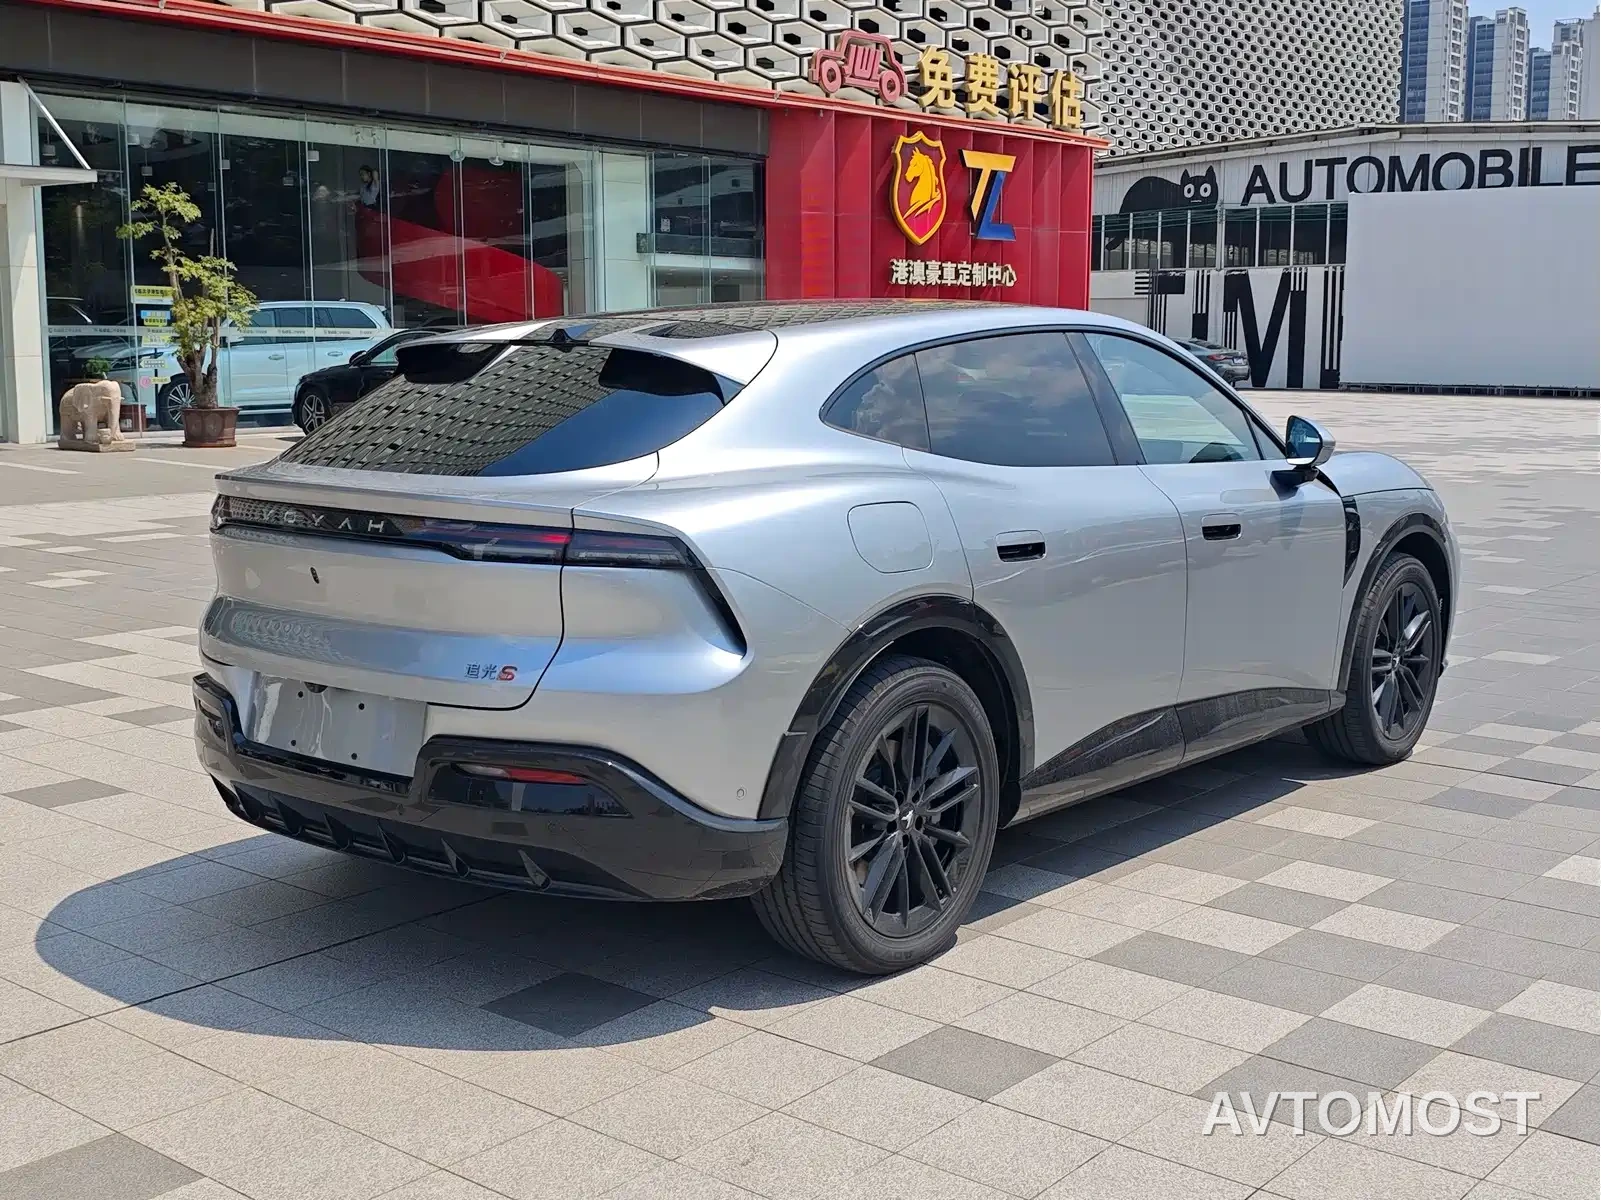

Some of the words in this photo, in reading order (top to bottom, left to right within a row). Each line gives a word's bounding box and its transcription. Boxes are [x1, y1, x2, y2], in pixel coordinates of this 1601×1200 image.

[918, 45, 1081, 130] 免费评估
[959, 149, 1017, 241] TL
[1240, 144, 1600, 207] AUTOMOBILE
[890, 259, 1018, 287] 港澳豪車定制中心
[262, 509, 385, 533] VOYAH
